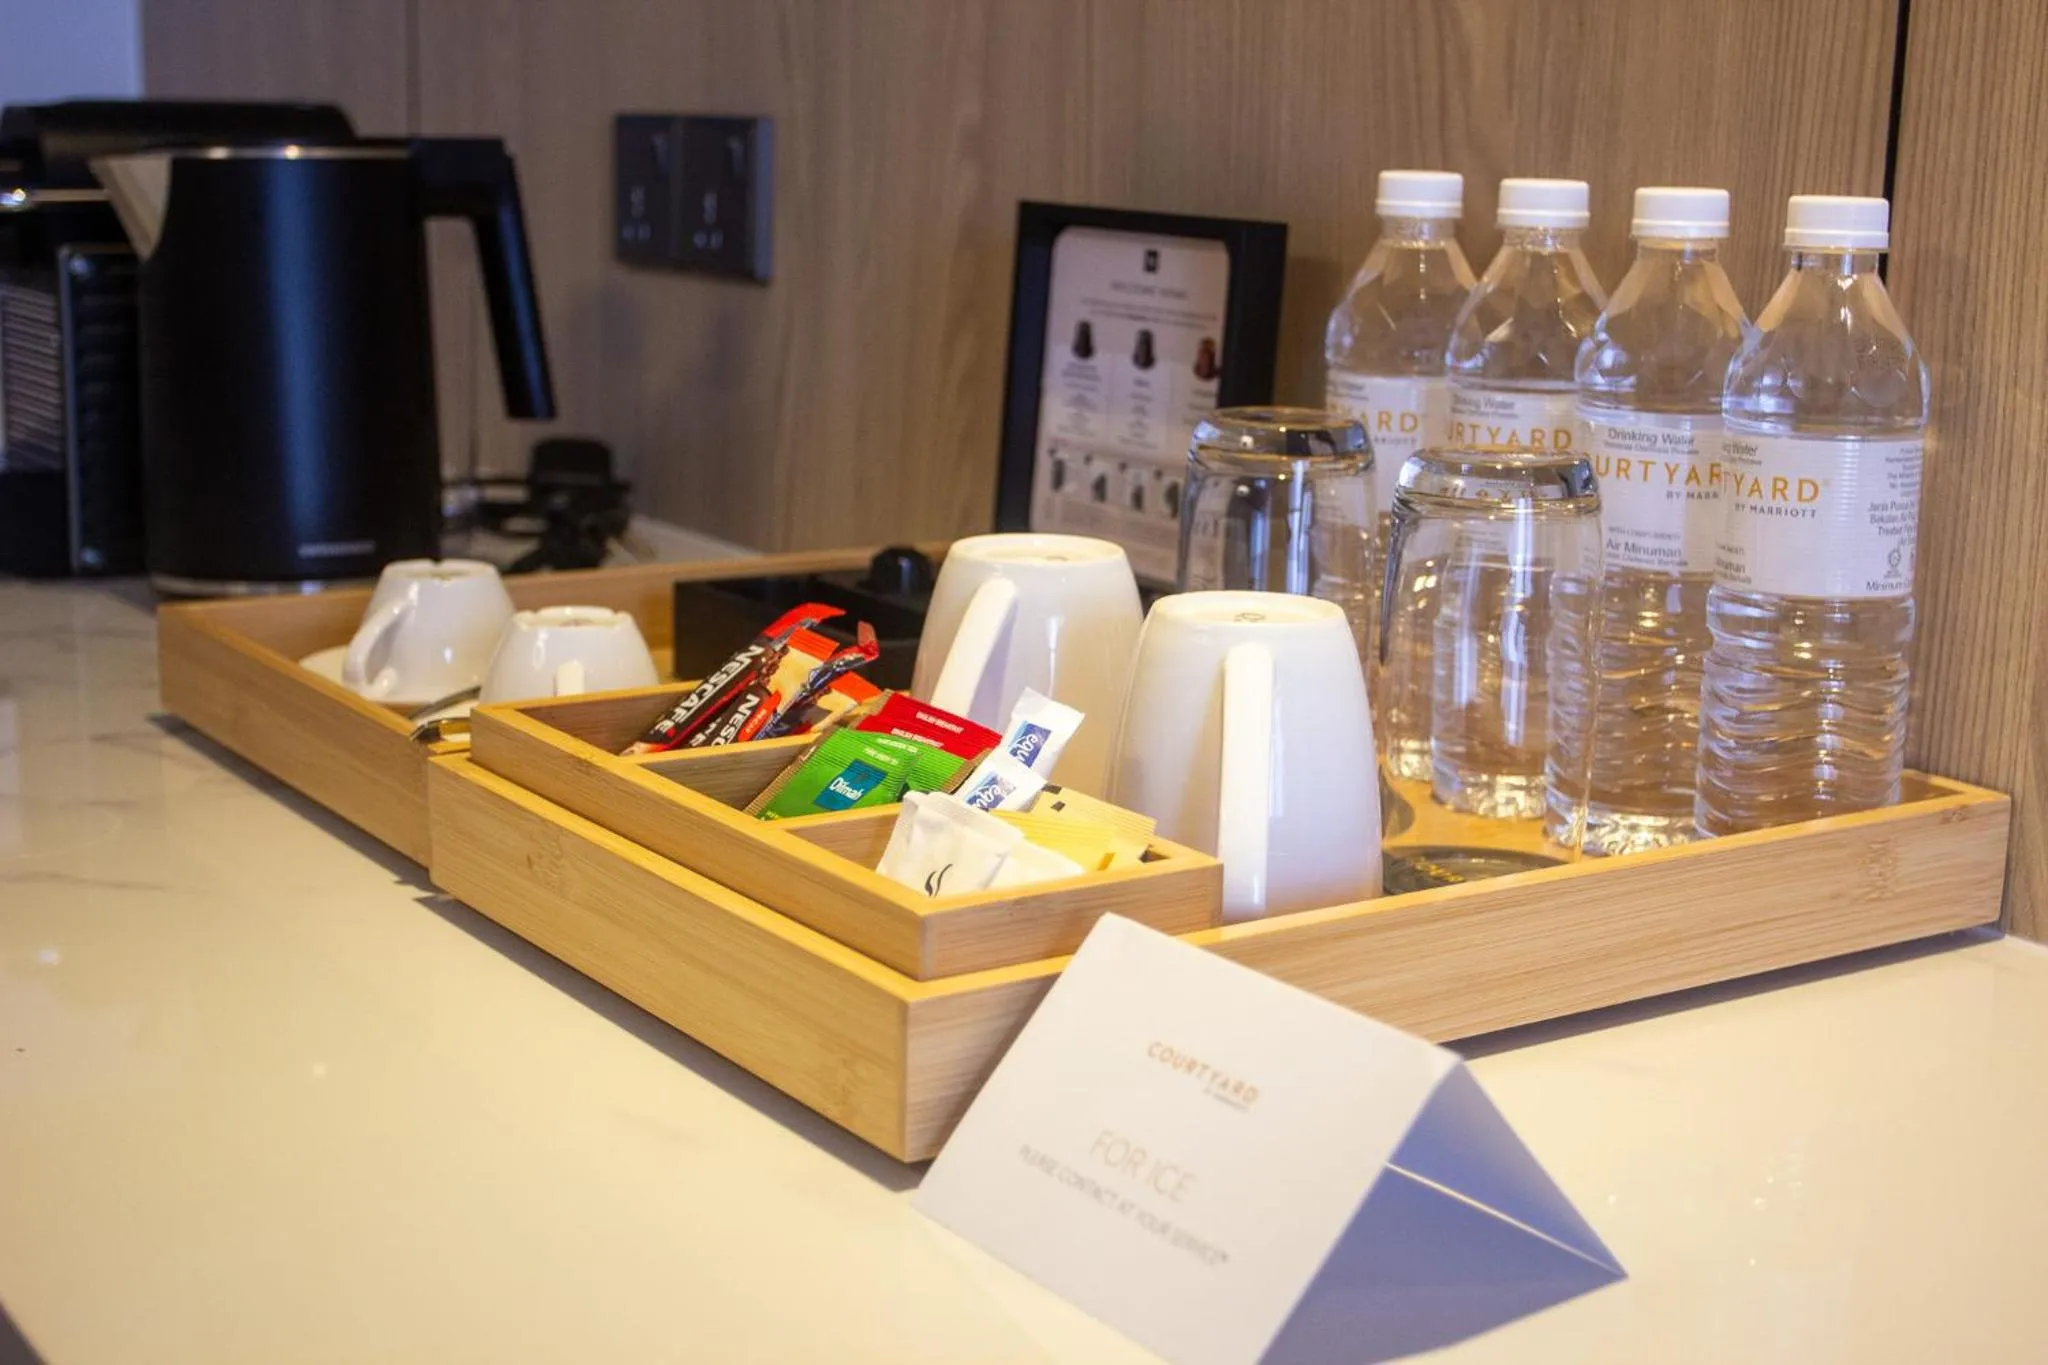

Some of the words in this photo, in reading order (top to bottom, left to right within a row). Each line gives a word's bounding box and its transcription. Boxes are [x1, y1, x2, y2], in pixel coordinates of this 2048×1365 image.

[1607, 427, 1658, 445] Drinking
[1749, 503, 1817, 519] MARRIOTT
[1606, 538, 1622, 550] Air
[828, 776, 866, 801] Dilmah
[1146, 1039, 1261, 1106] COURTYARD
[1089, 1128, 1149, 1181] FOR
[1146, 1156, 1199, 1204] ICE
